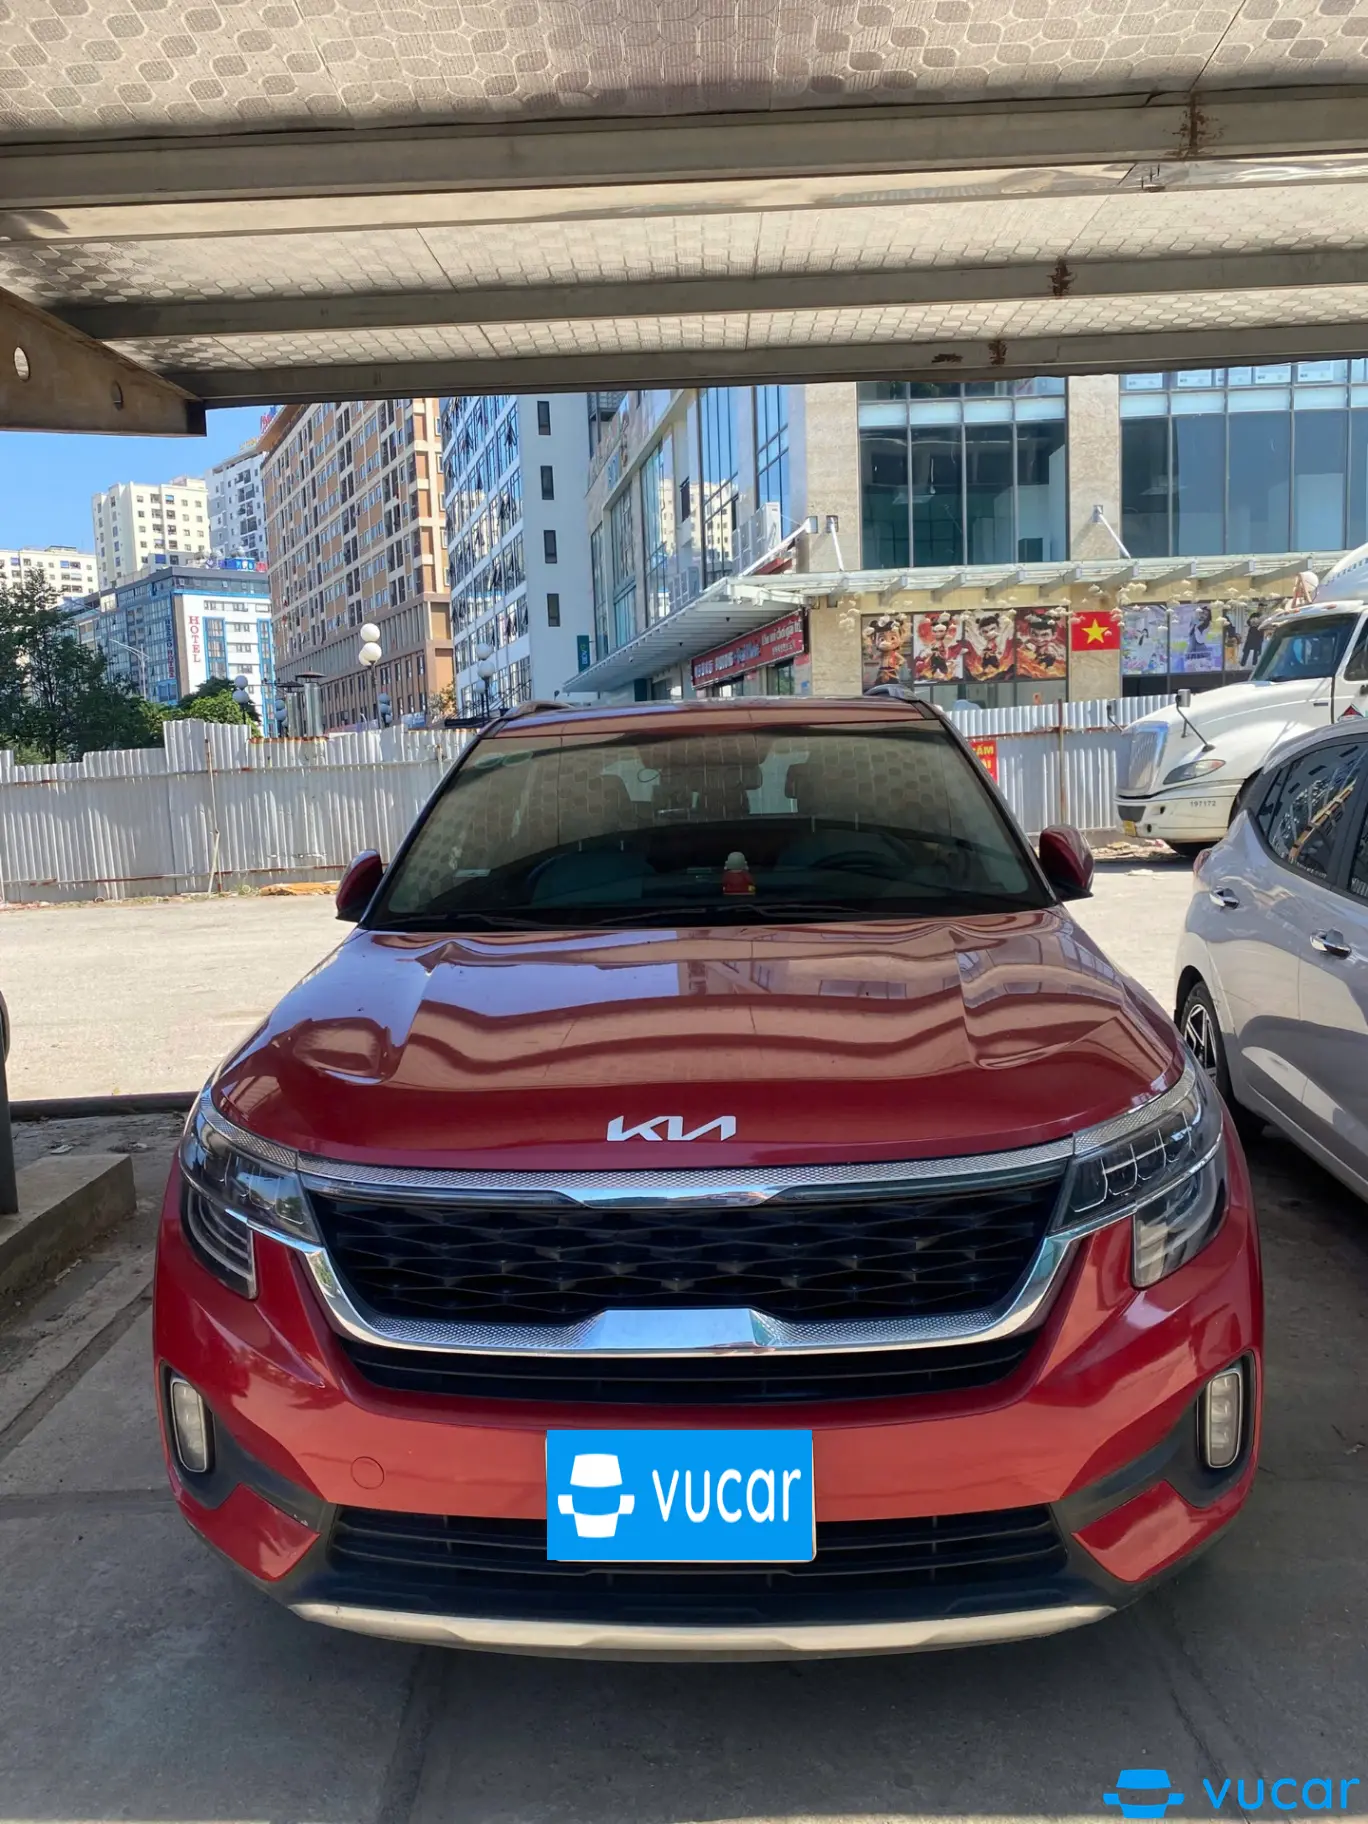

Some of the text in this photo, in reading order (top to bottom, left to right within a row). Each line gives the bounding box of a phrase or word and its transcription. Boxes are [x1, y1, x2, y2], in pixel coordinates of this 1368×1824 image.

[188, 616, 200, 662] HOTEL
[972, 743, 994, 755] ẤM
[1189, 800, 1216, 808] 197172
[606, 1115, 737, 1142] KIA
